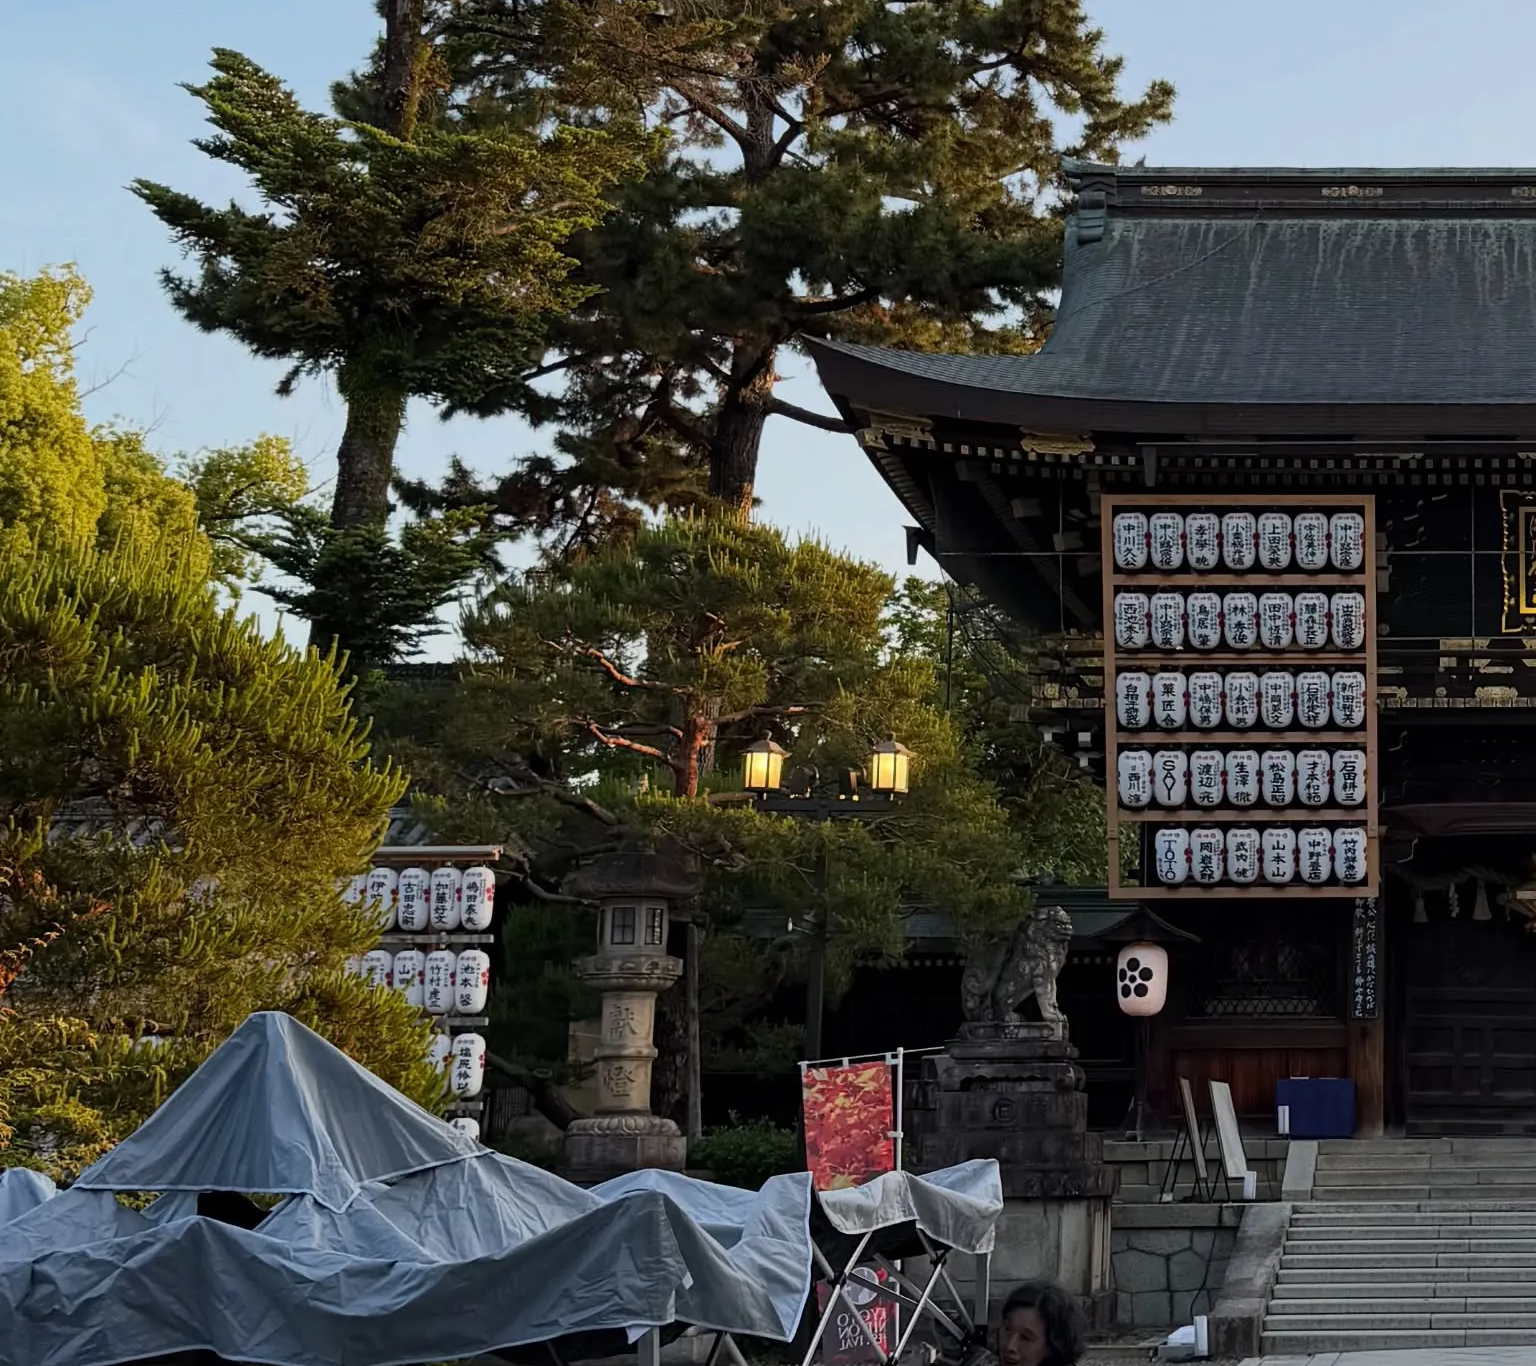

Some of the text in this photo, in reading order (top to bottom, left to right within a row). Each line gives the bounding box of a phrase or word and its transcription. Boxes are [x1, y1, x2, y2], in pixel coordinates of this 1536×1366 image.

[1163, 760, 1176, 801] SAY
[1164, 840, 1176, 881] TOTO
[1272, 841, 1285, 879] 山本山
